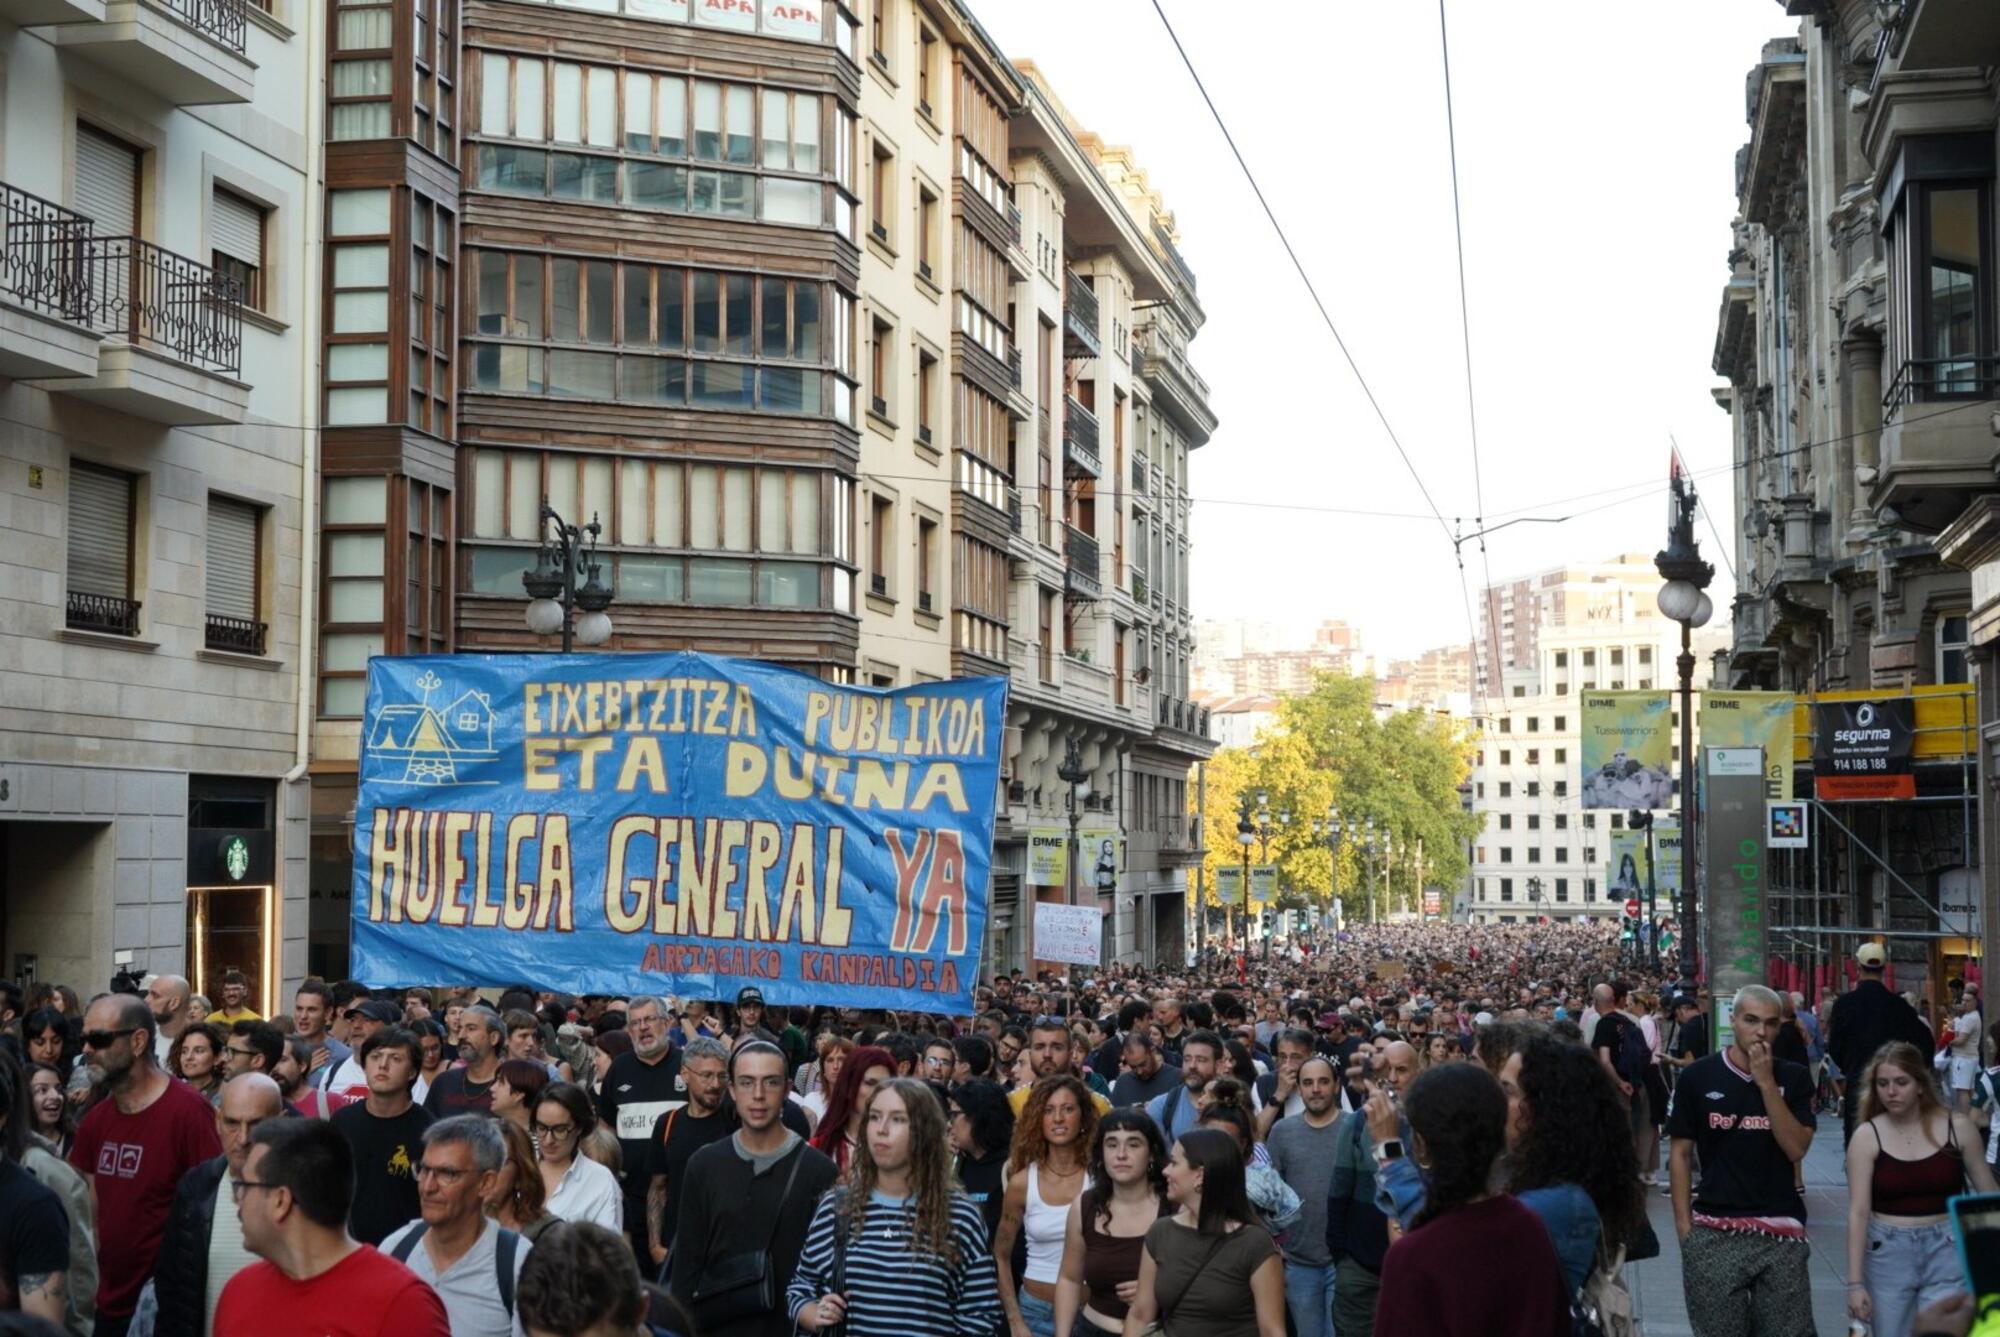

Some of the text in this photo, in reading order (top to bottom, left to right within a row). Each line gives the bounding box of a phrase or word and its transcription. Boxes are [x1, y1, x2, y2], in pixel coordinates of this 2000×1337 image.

[1587, 604, 1612, 620] NYX
[1710, 700, 1741, 710] BIME
[524, 677, 986, 757] ETXEBIZITZA PUBLIKOA
[1834, 728, 1891, 744] segurma
[1834, 758, 1887, 770] 914 188 188
[524, 735, 970, 813] ETA DUINA
[1033, 837, 1063, 848] BIME
[1659, 838, 1683, 848] BIM
[368, 807, 575, 933] HUELGA
[603, 814, 855, 948] GENERAL
[884, 827, 969, 955] YA
[1731, 838, 1761, 976] Abando
[1941, 902, 1977, 913] Ibarrea
[640, 942, 960, 994] ARRIAGAKO KANPALDIA
